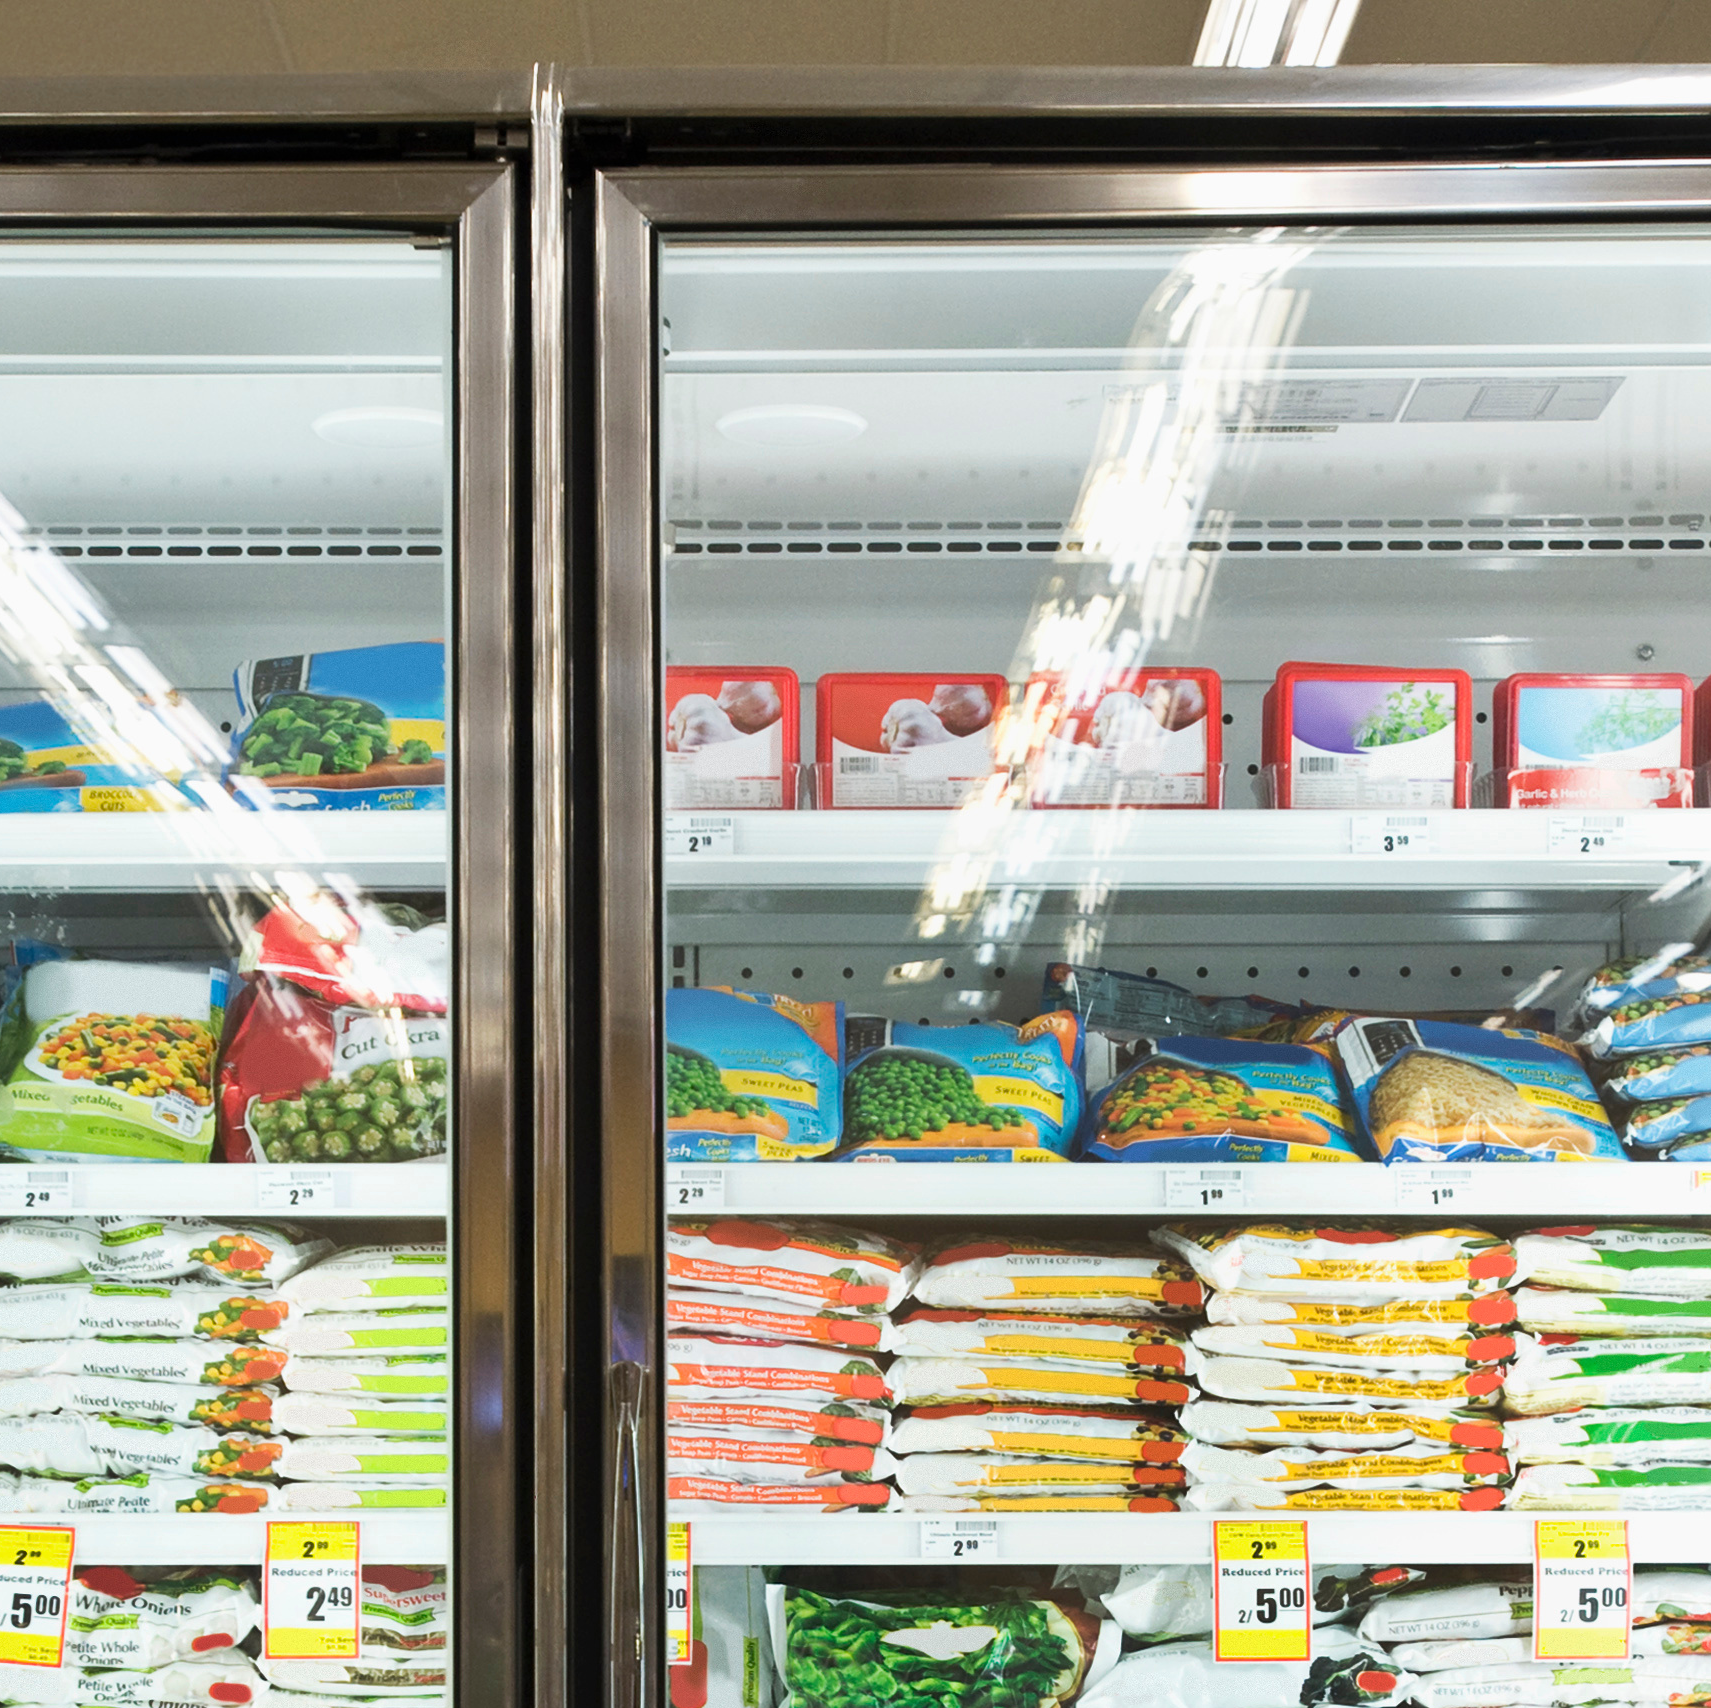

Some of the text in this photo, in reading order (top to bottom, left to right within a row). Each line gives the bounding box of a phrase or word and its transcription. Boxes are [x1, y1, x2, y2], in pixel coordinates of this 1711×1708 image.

[1310, 1152, 1341, 1161] MIXED
[271, 1567, 357, 1578] Reduced Price
[1222, 1568, 1305, 1578] Reduced Price
